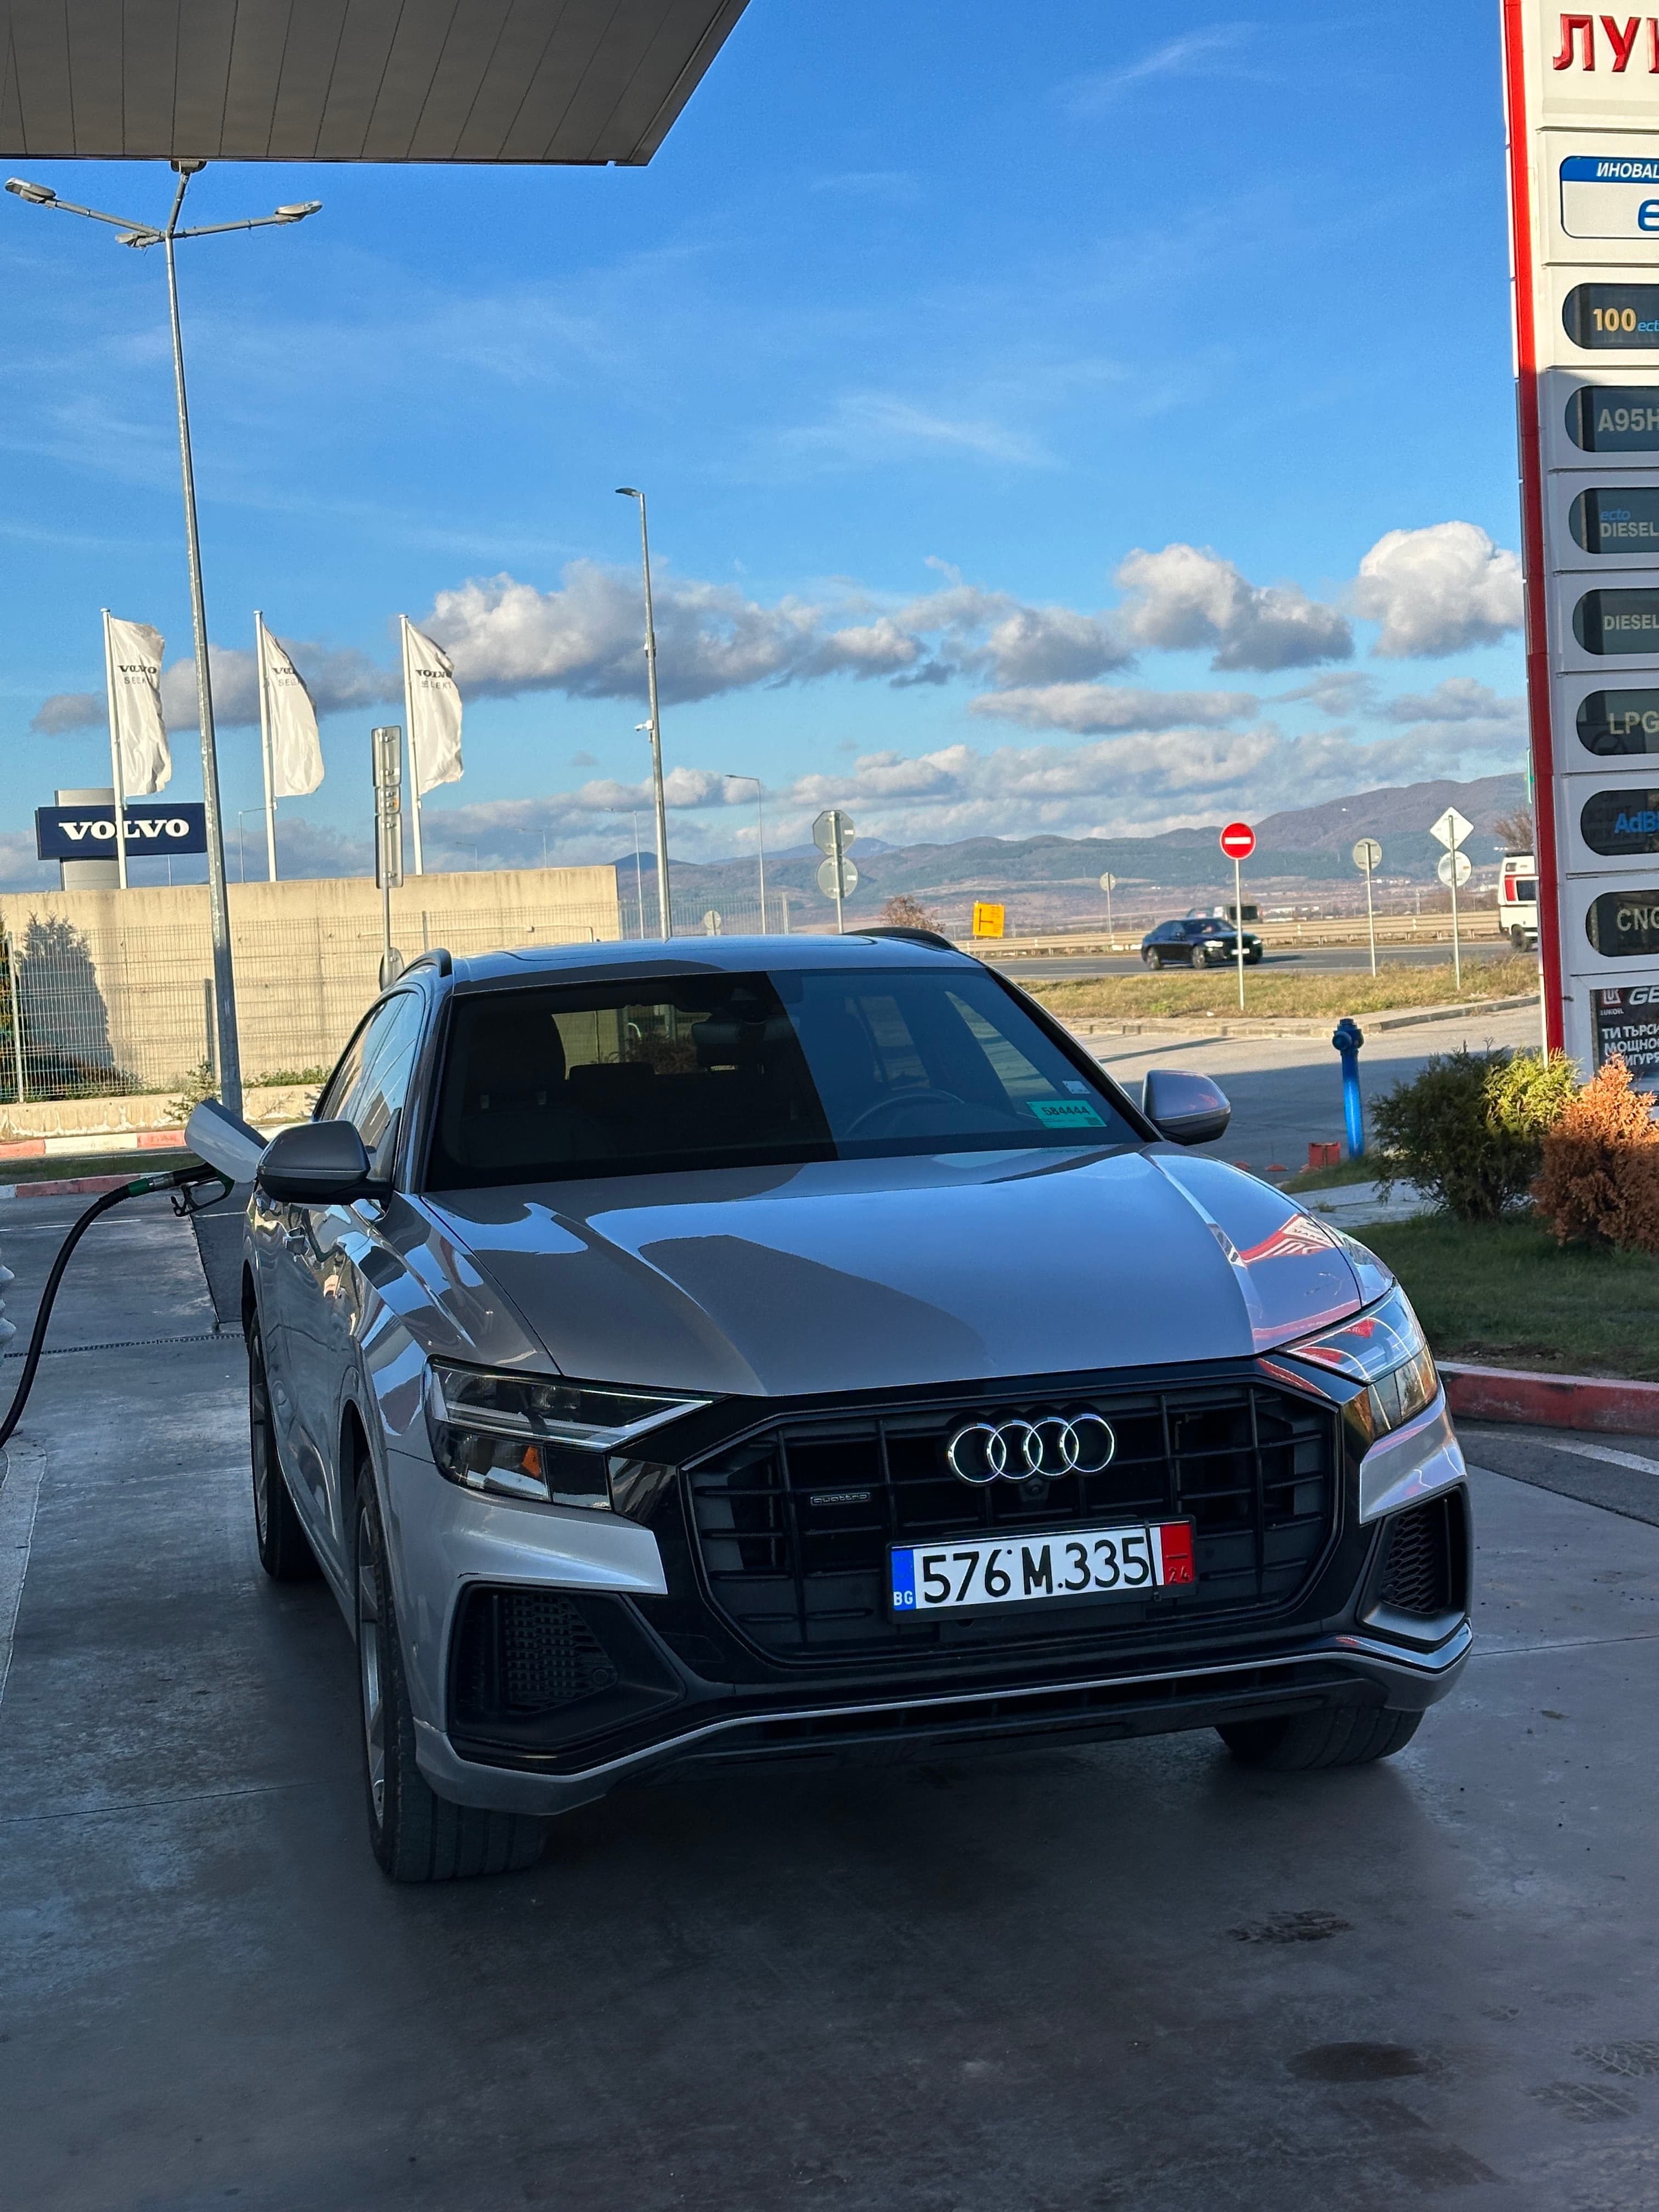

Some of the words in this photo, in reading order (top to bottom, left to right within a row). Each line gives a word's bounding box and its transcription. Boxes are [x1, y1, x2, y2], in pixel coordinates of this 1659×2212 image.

[1593, 308, 1637, 332] 100
[1600, 509, 1631, 521] ecto
[1600, 522, 1659, 538] DIESEL
[1603, 614, 1659, 630] DIESEL
[1609, 711, 1659, 735] LPG
[59, 819, 189, 840] VOLVO
[1041, 1106, 1090, 1116] 584444
[893, 1591, 913, 1606] BG
